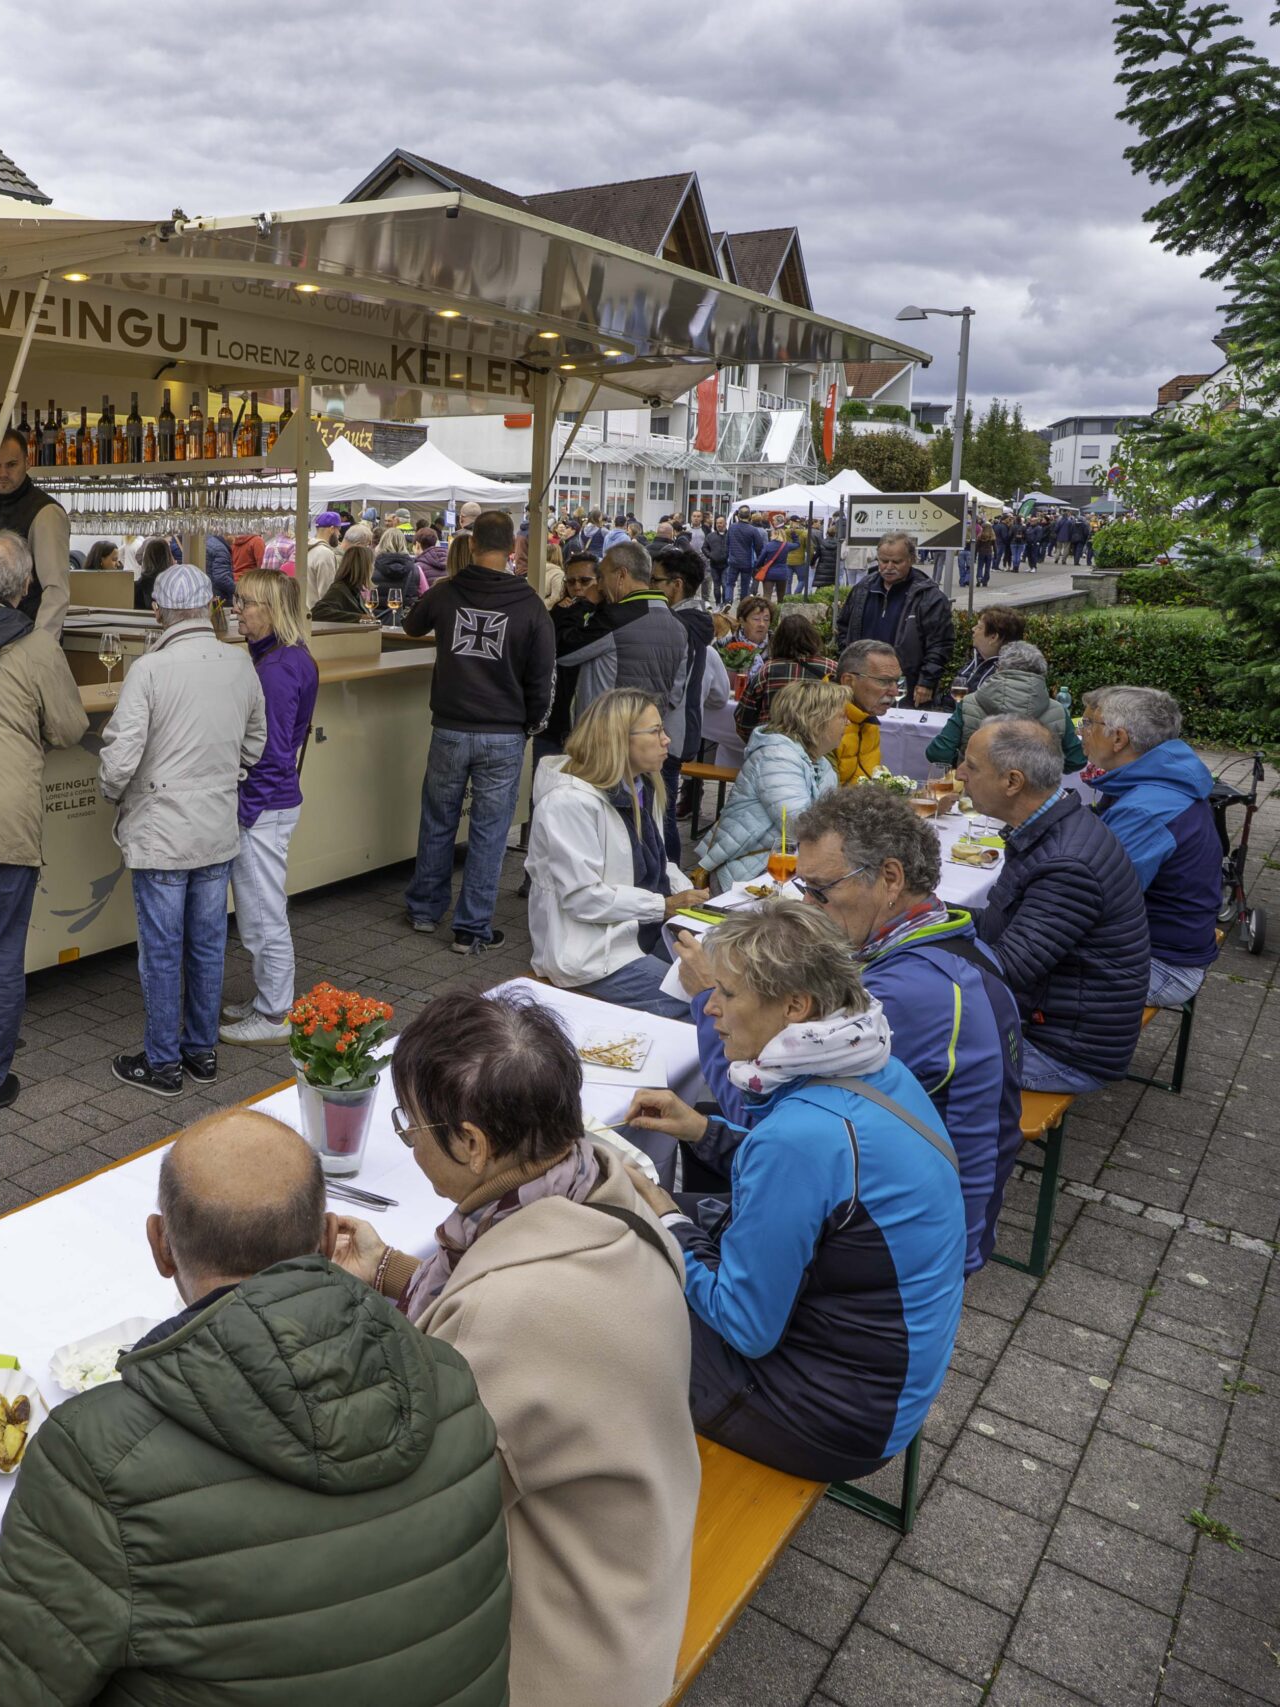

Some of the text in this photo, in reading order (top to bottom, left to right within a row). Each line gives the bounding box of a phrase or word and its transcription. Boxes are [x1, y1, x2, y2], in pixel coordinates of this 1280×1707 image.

[217, 340, 300, 368] LORENZ
[304, 353, 317, 372] &
[320, 355, 389, 380] CORINA
[390, 344, 531, 398] KELLER
[876, 509, 943, 520] PELUSO
[45, 777, 97, 793] WEINGUT
[45, 796, 97, 814] KELLER
